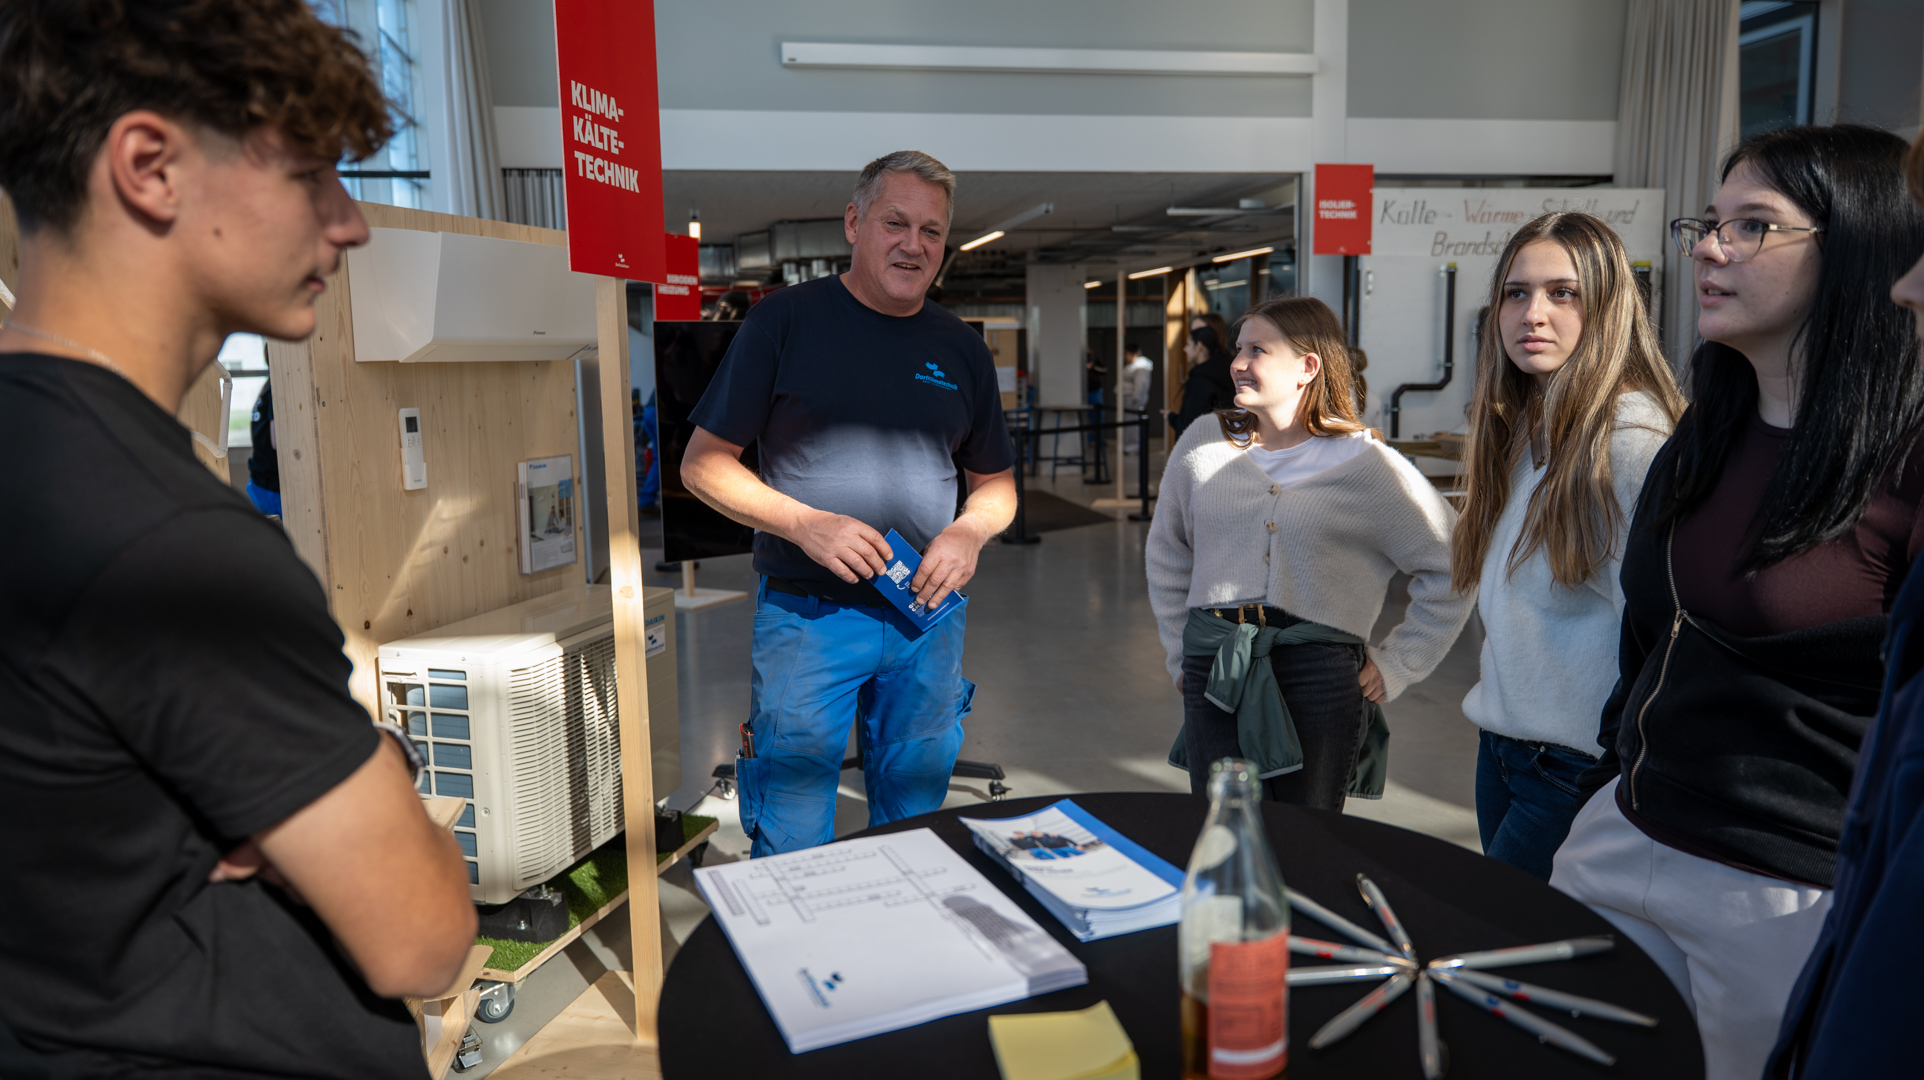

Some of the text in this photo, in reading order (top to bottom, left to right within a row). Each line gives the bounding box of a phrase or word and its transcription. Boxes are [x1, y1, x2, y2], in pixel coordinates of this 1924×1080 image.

[571, 80, 624, 122] KLIMA-
[573, 113, 624, 154] KÄLTE-
[574, 150, 640, 193] TECHNIK
[1319, 199, 1356, 209] ISOLIER-
[1319, 210, 1357, 219] TECHNIK
[658, 284, 690, 296] HEIZUNG
